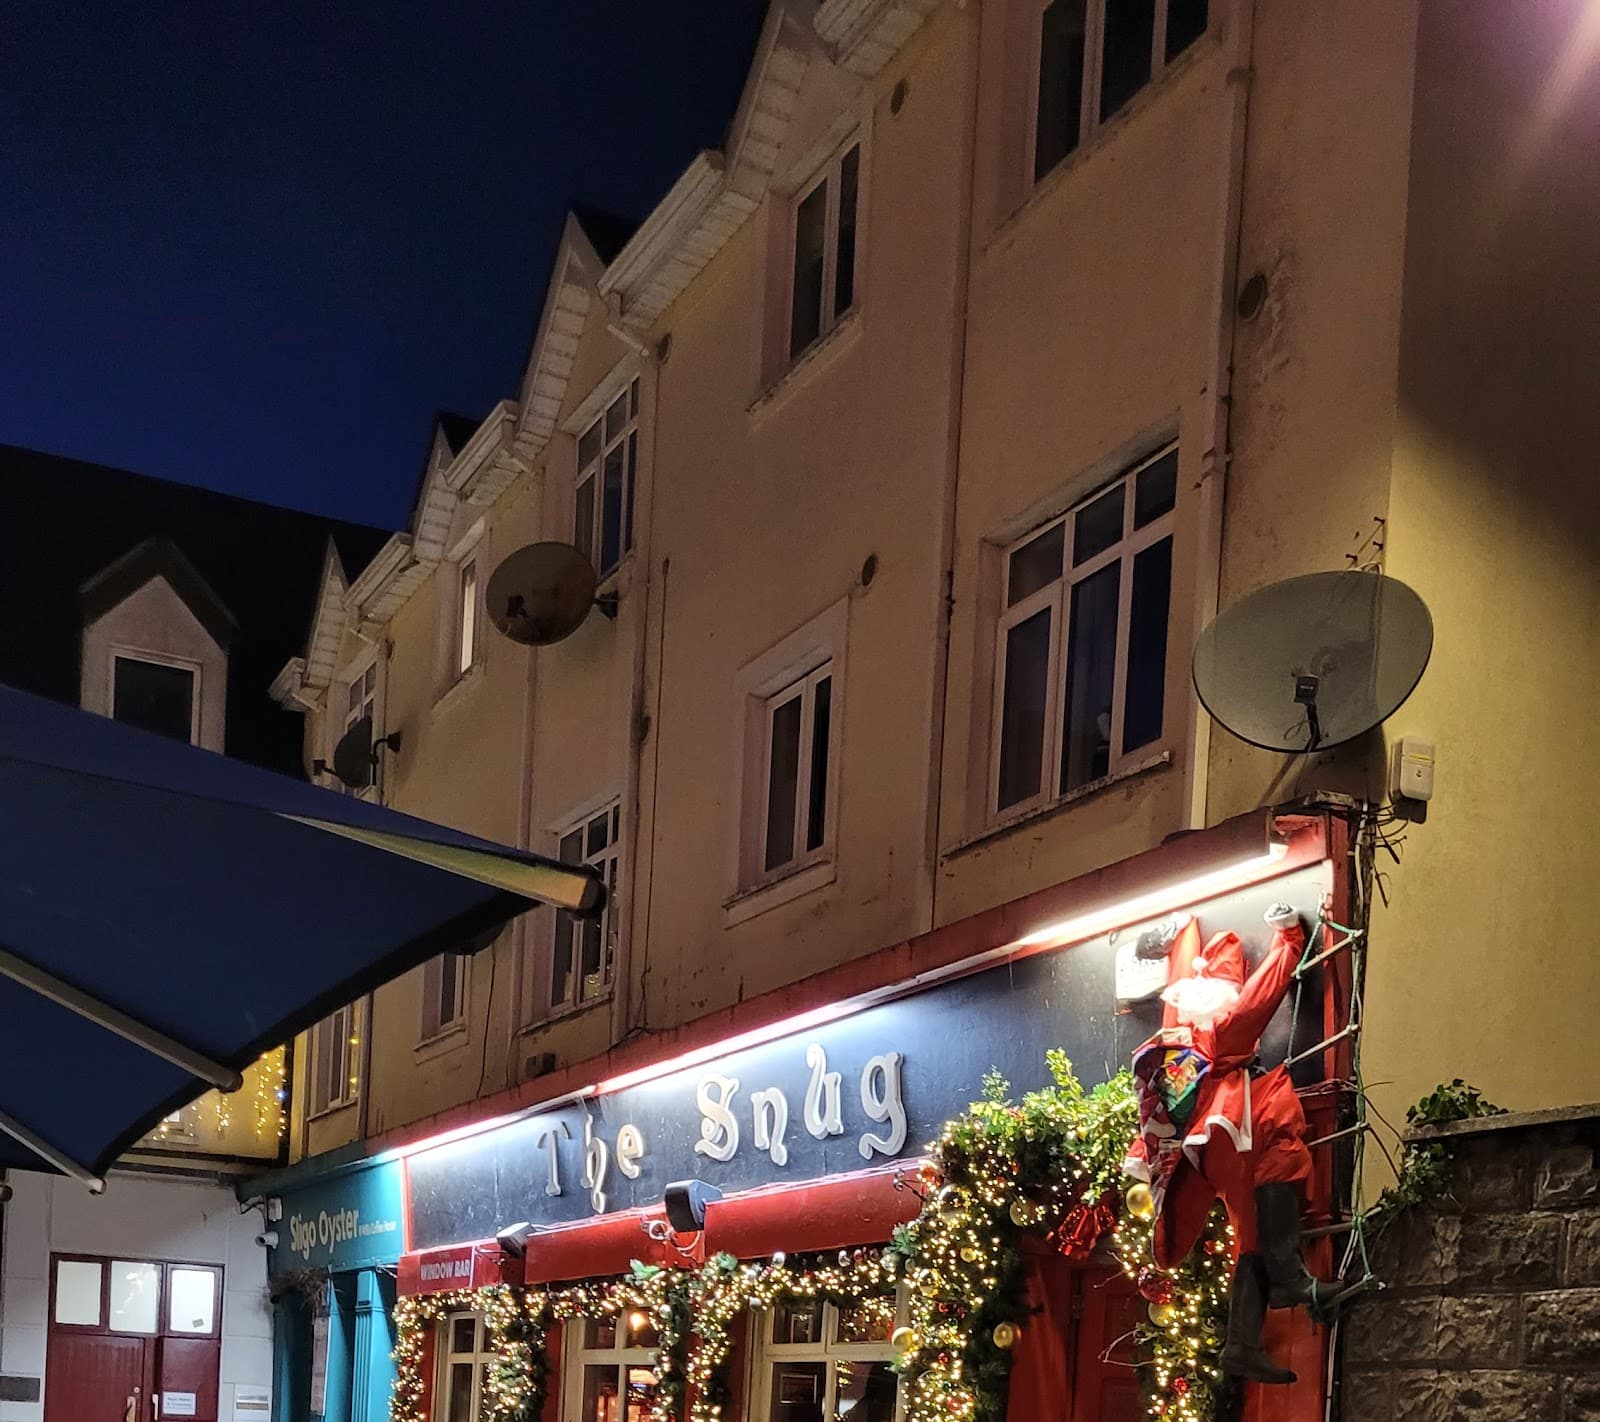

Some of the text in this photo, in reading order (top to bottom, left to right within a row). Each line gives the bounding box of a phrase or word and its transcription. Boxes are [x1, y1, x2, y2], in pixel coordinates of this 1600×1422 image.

[537, 1042, 909, 1214] The Snug
[290, 1207, 359, 1260] Sligo Oyster
[420, 1259, 471, 1281] WINDOW BAR
